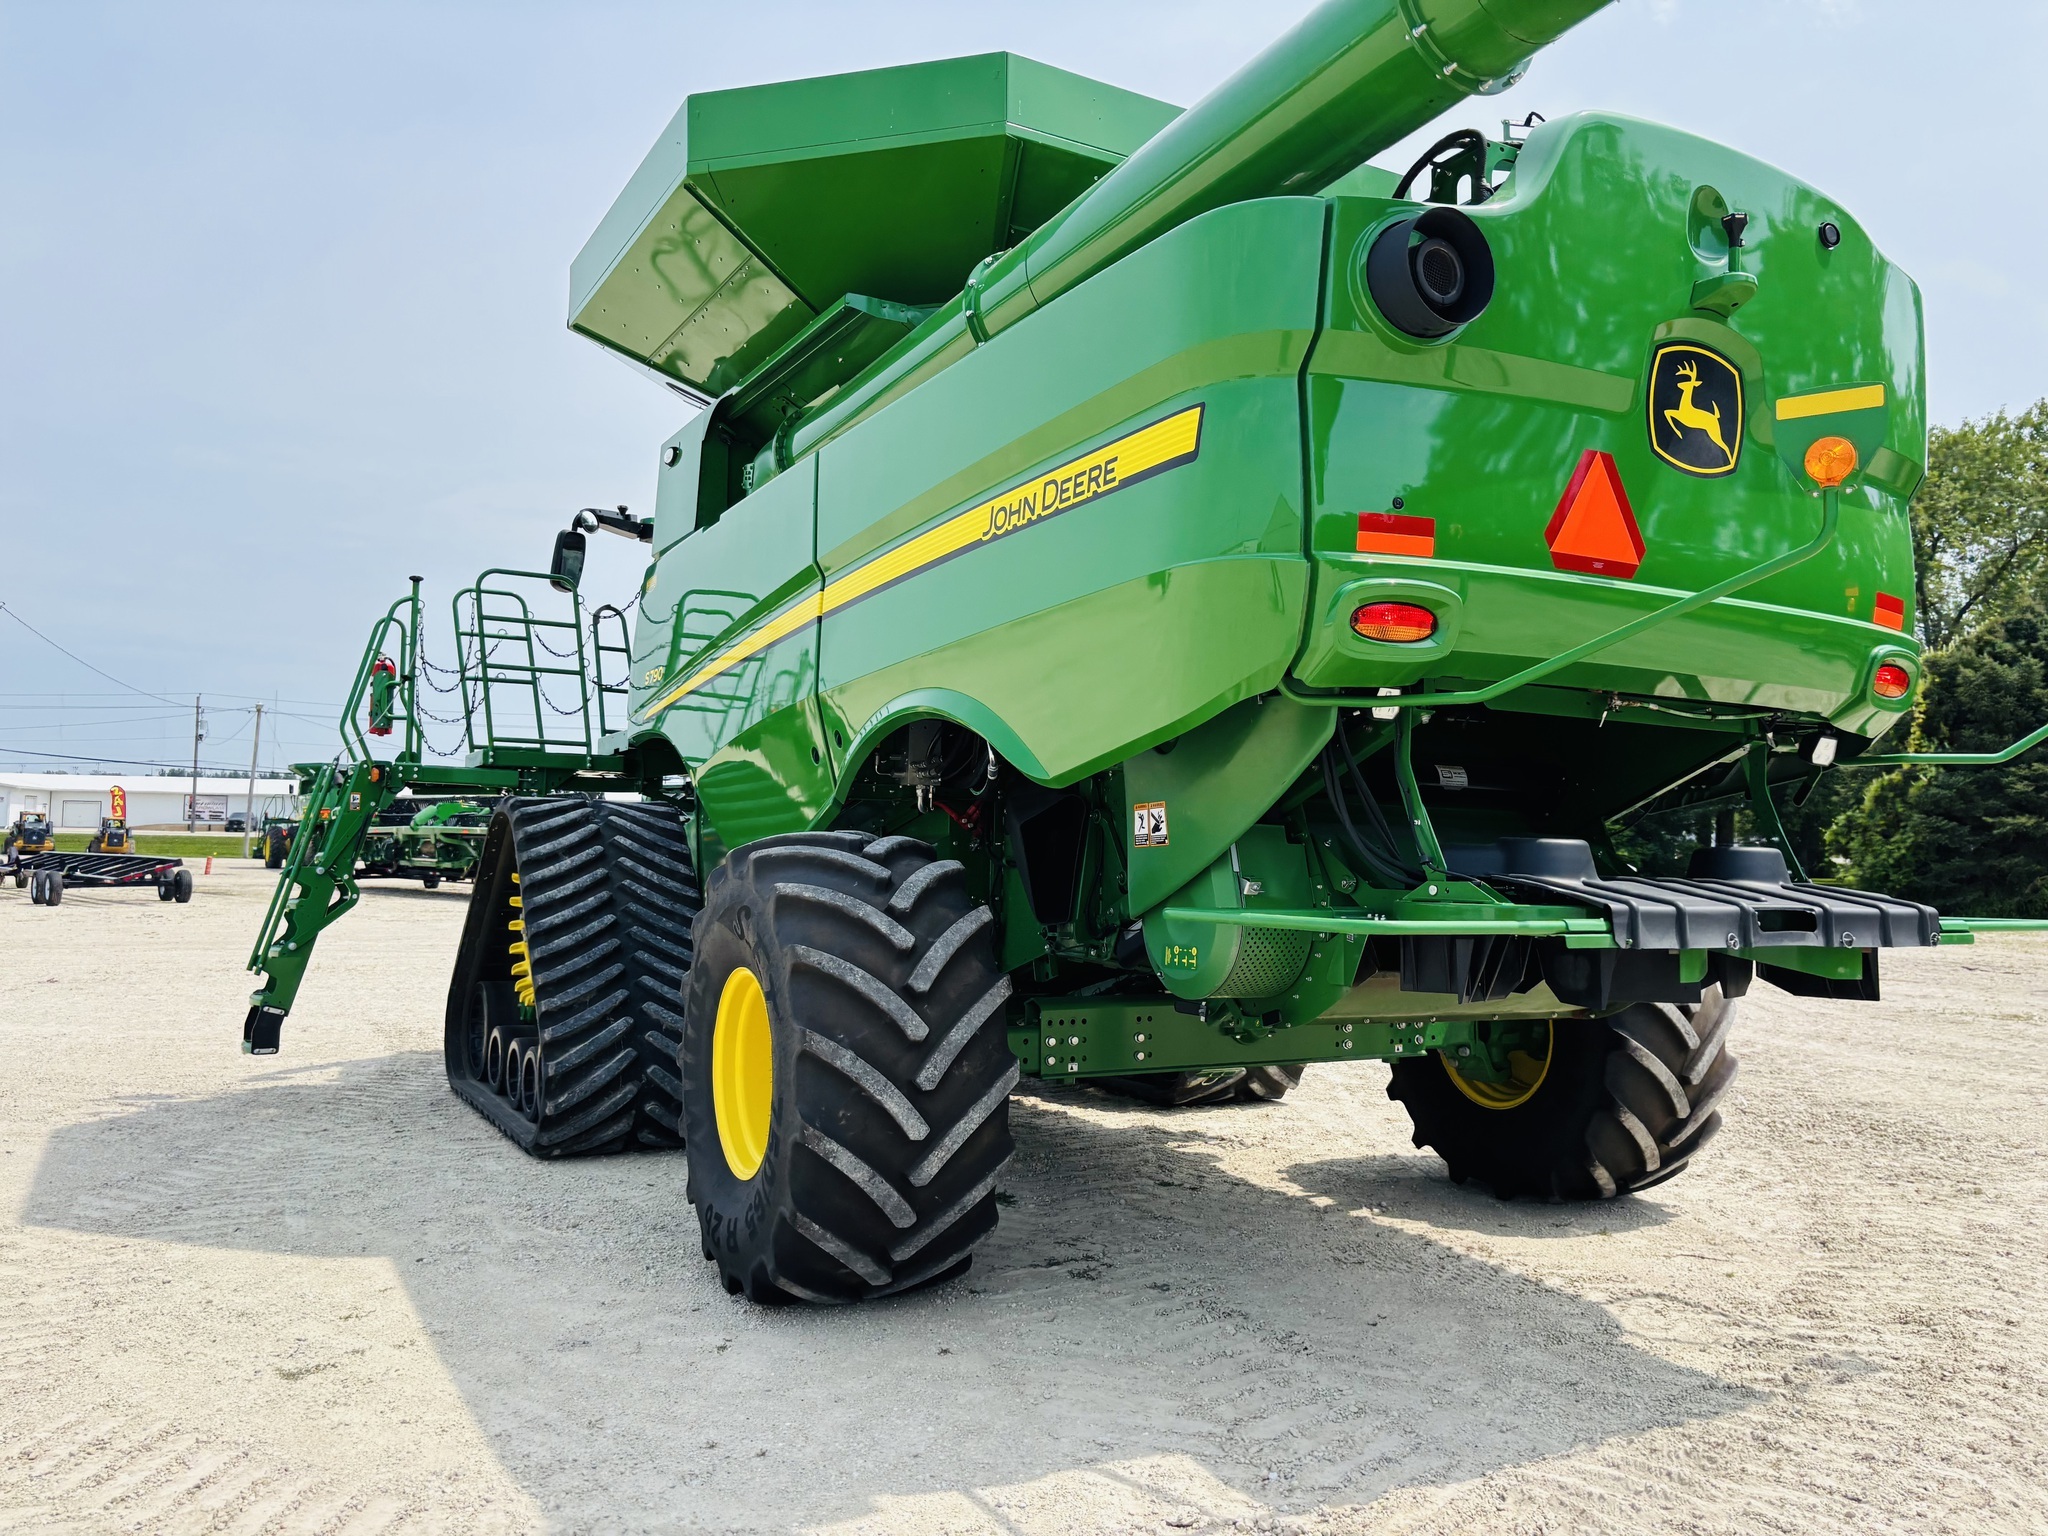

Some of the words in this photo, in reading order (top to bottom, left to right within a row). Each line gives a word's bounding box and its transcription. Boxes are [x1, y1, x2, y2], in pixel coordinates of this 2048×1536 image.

[982, 492, 1037, 537] JOHN
[1041, 457, 1118, 512] DEERE
[645, 666, 664, 685] S790
